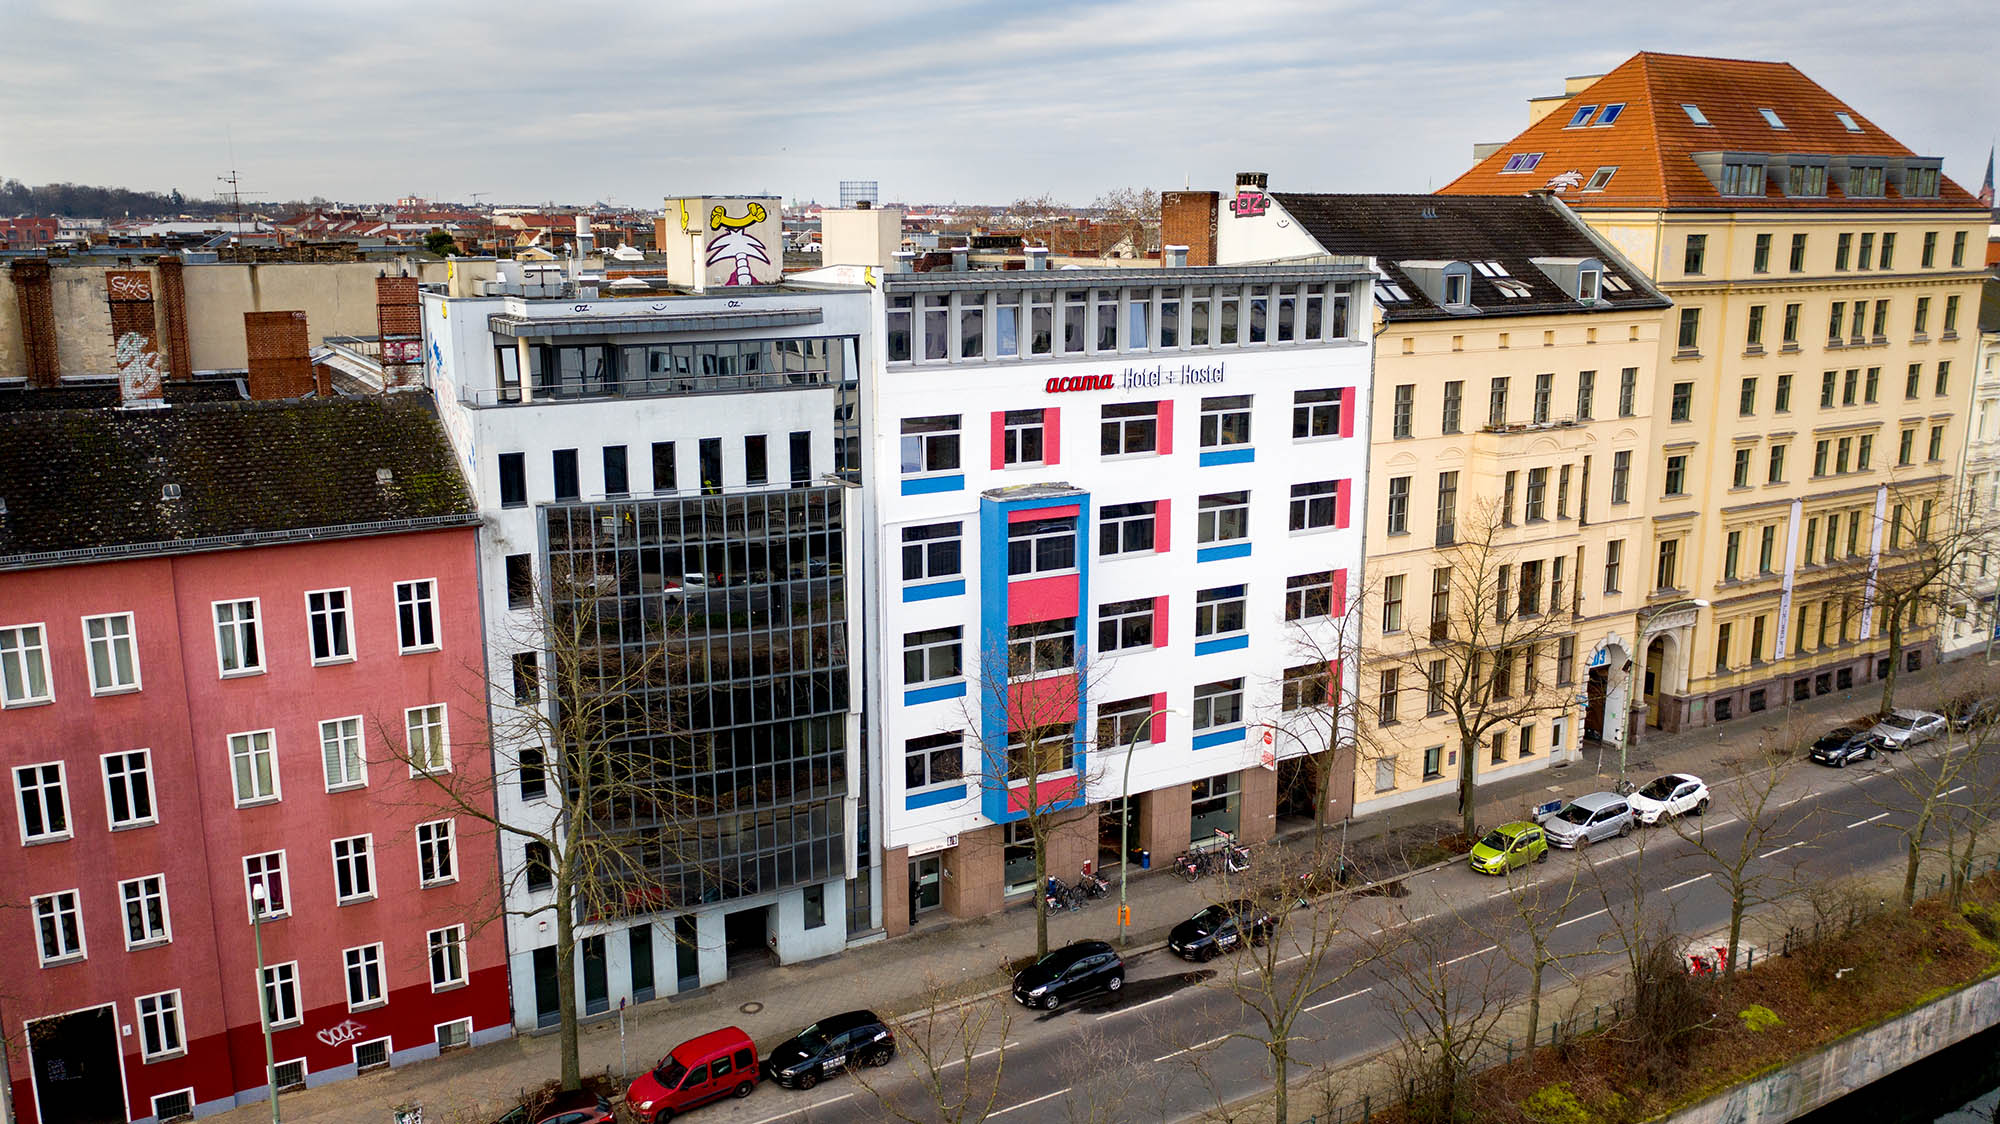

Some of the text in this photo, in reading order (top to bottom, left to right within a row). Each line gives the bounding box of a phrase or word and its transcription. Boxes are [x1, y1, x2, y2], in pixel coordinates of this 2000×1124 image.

[1046, 374, 1115, 394] acama
[1123, 365, 1161, 389] Hotel
[1181, 361, 1225, 385] Hostel
